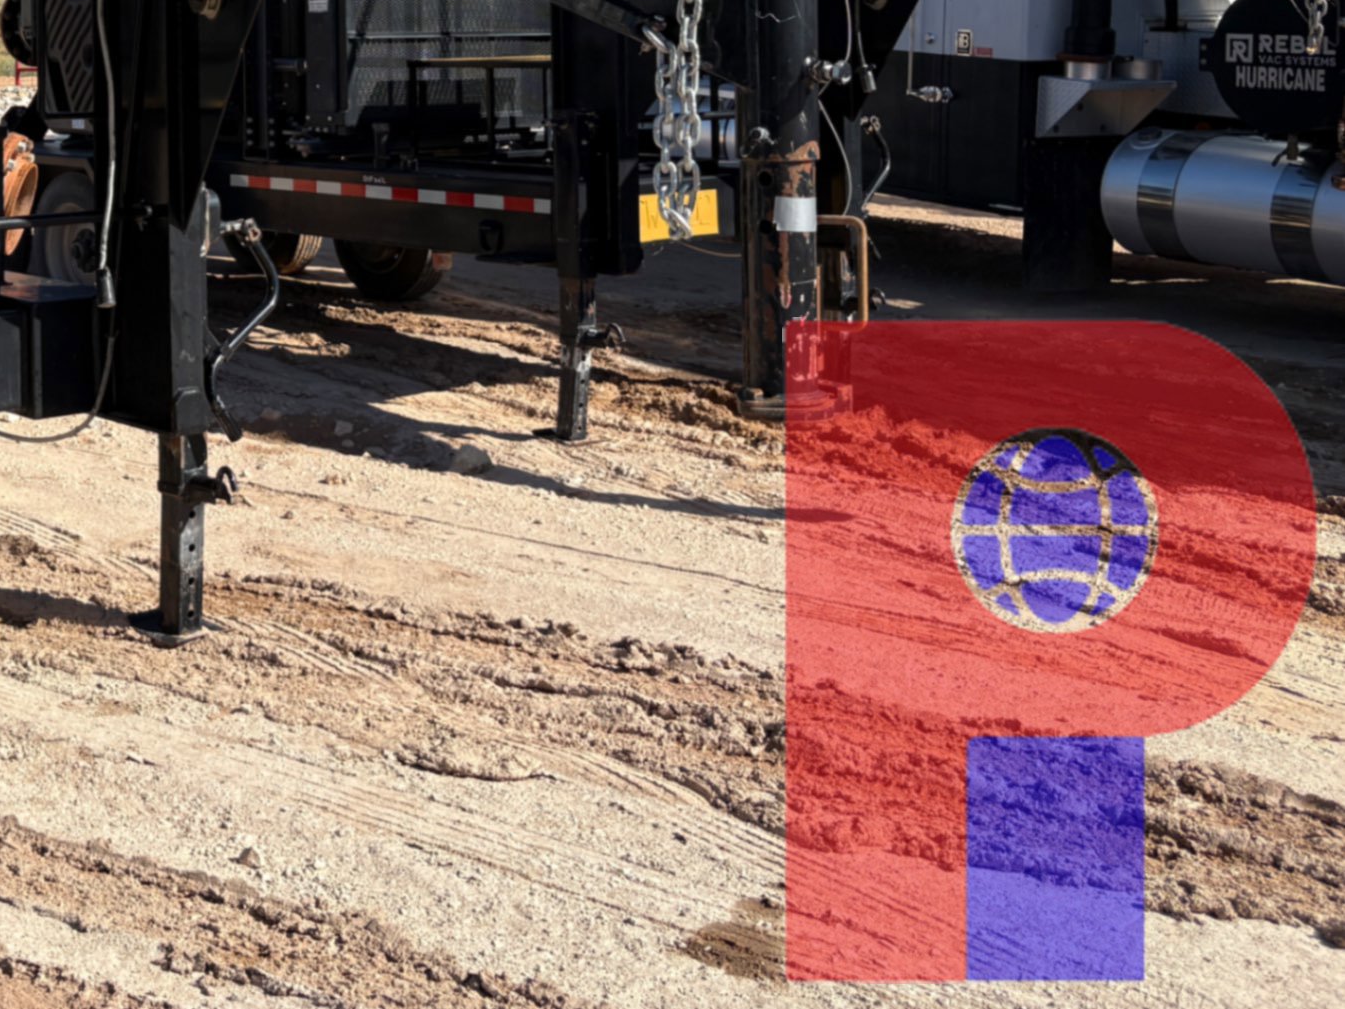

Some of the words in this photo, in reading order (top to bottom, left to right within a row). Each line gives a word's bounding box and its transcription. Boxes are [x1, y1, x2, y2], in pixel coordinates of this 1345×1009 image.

[1258, 33, 1337, 56] REBL
[1258, 54, 1282, 65] VAC
[1285, 55, 1337, 68] SYSTEMS
[1235, 65, 1326, 92] HURRICANE
